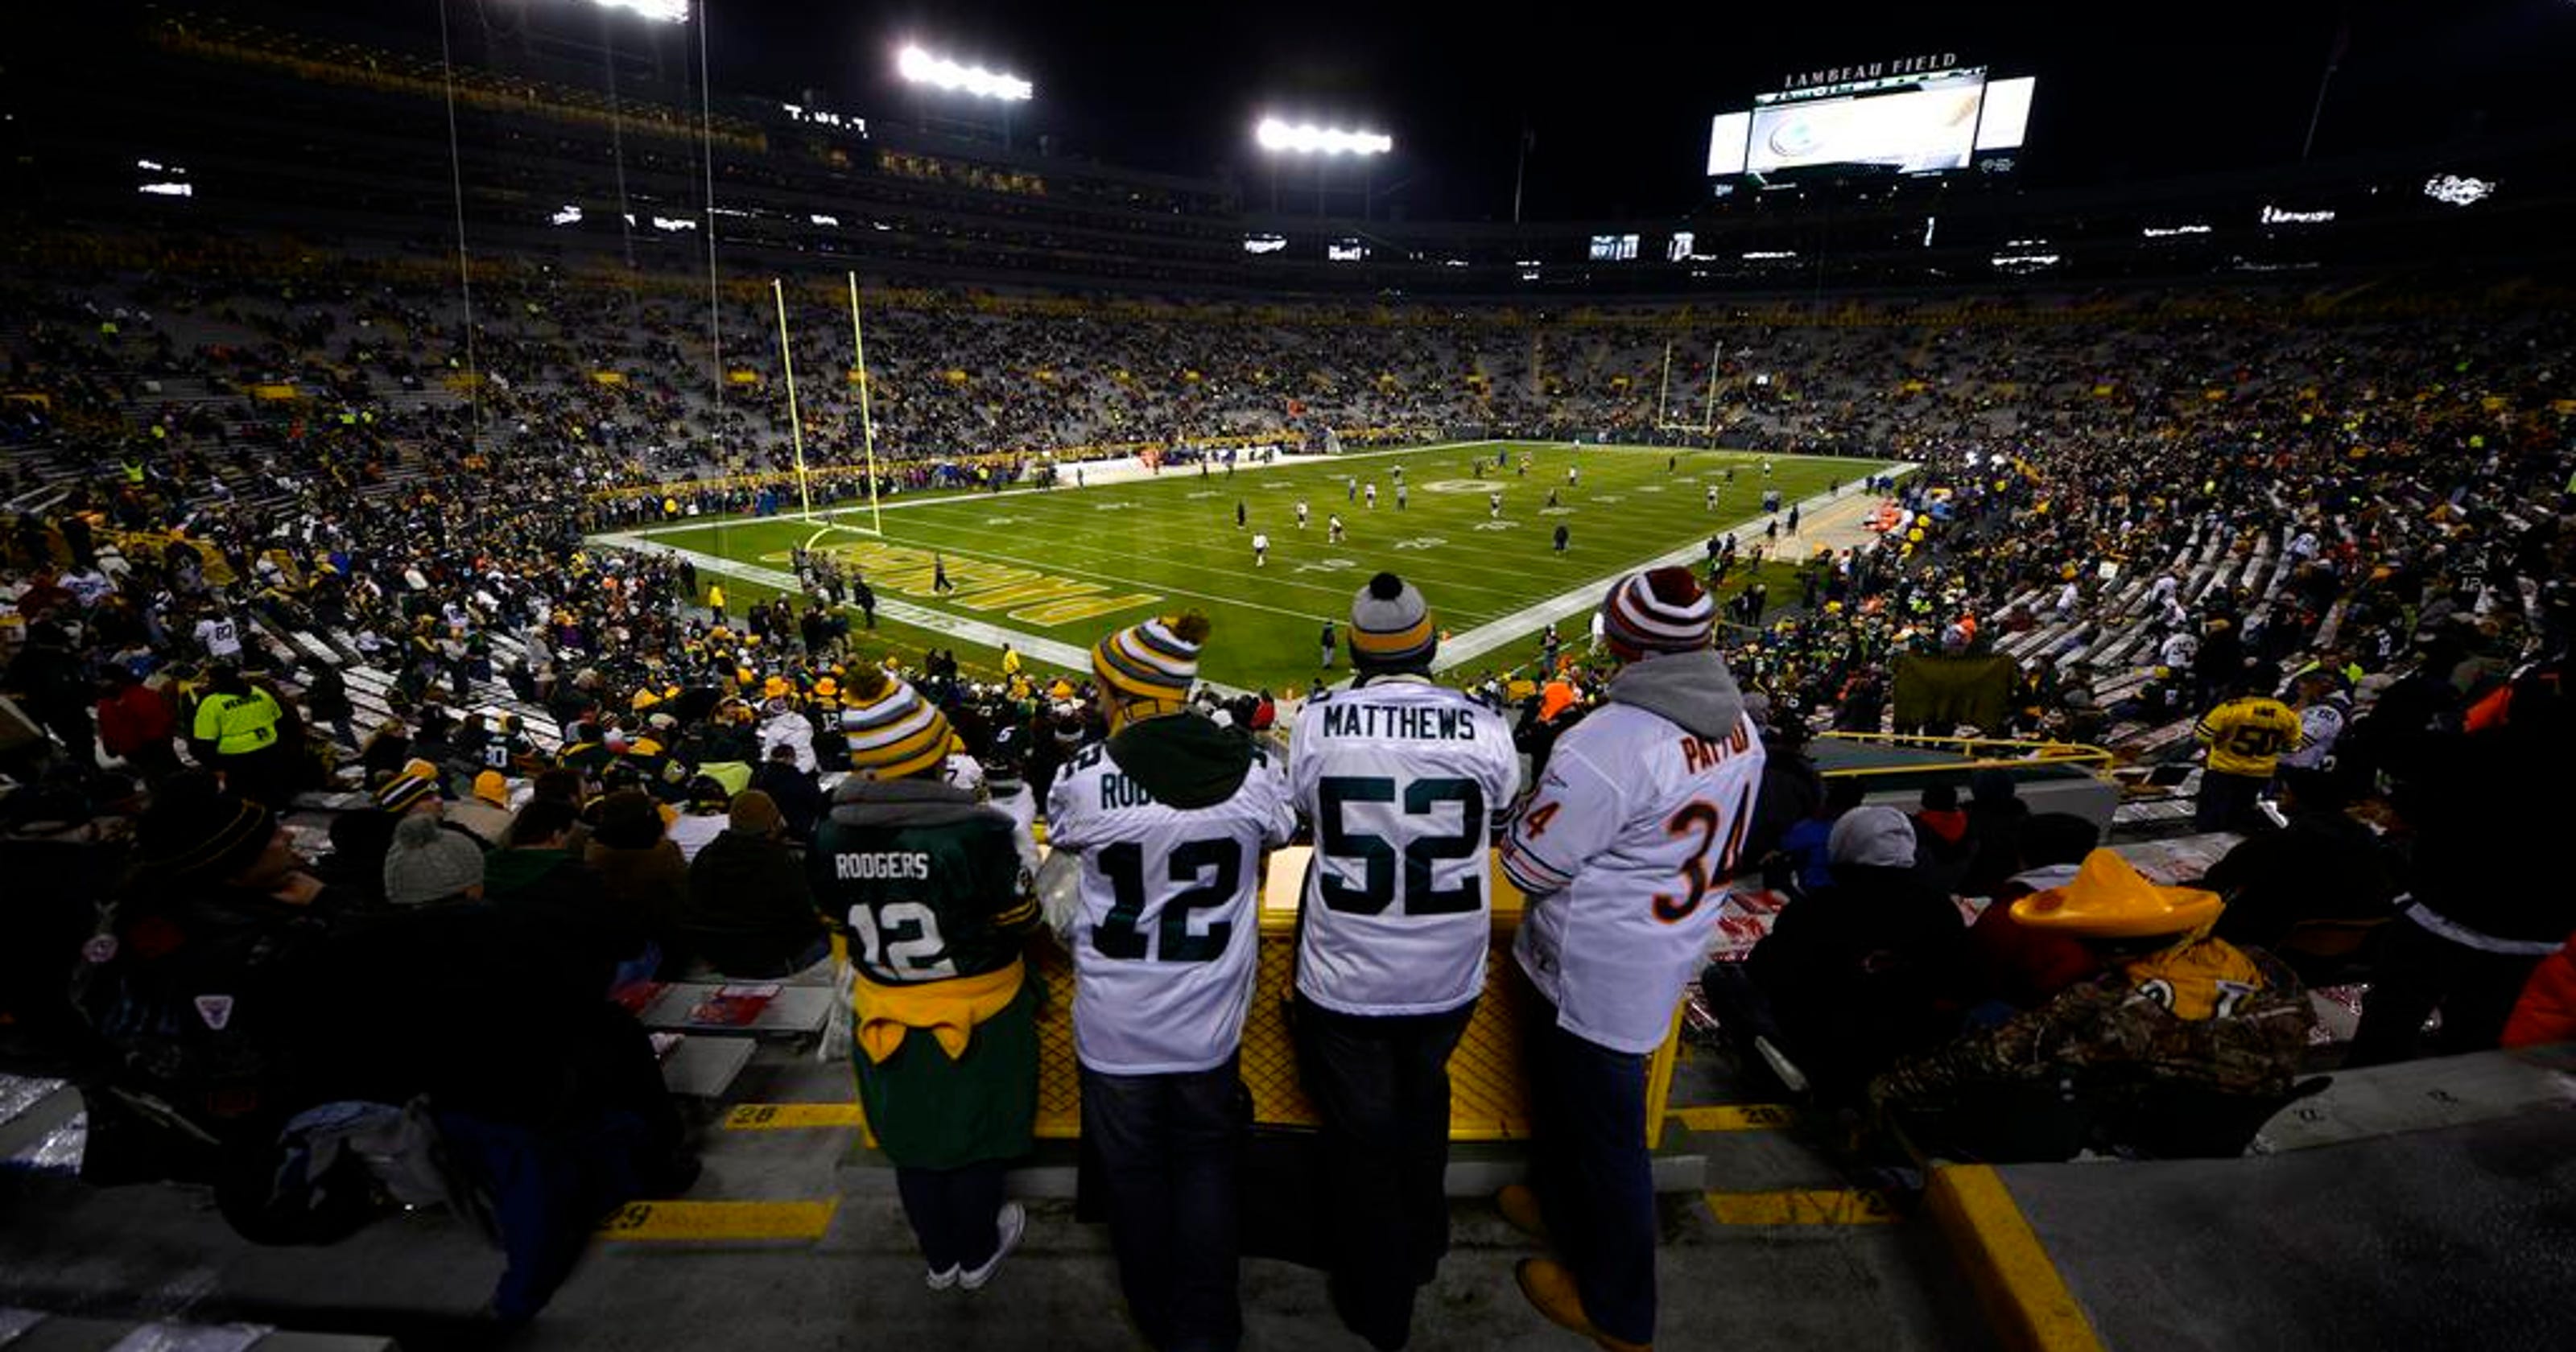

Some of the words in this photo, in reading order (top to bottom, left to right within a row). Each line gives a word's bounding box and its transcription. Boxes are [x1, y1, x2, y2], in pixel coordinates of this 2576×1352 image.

[1783, 62, 1881, 89] LAMBEAU
[1890, 52, 1956, 74] FIELD
[1323, 704, 1476, 740] MATTHEWS
[835, 851, 930, 881] RODGERS
[1319, 777, 1485, 916] 52
[1652, 778, 1752, 924] 34
[1092, 836, 1242, 962] 12
[848, 901, 956, 982] 12
